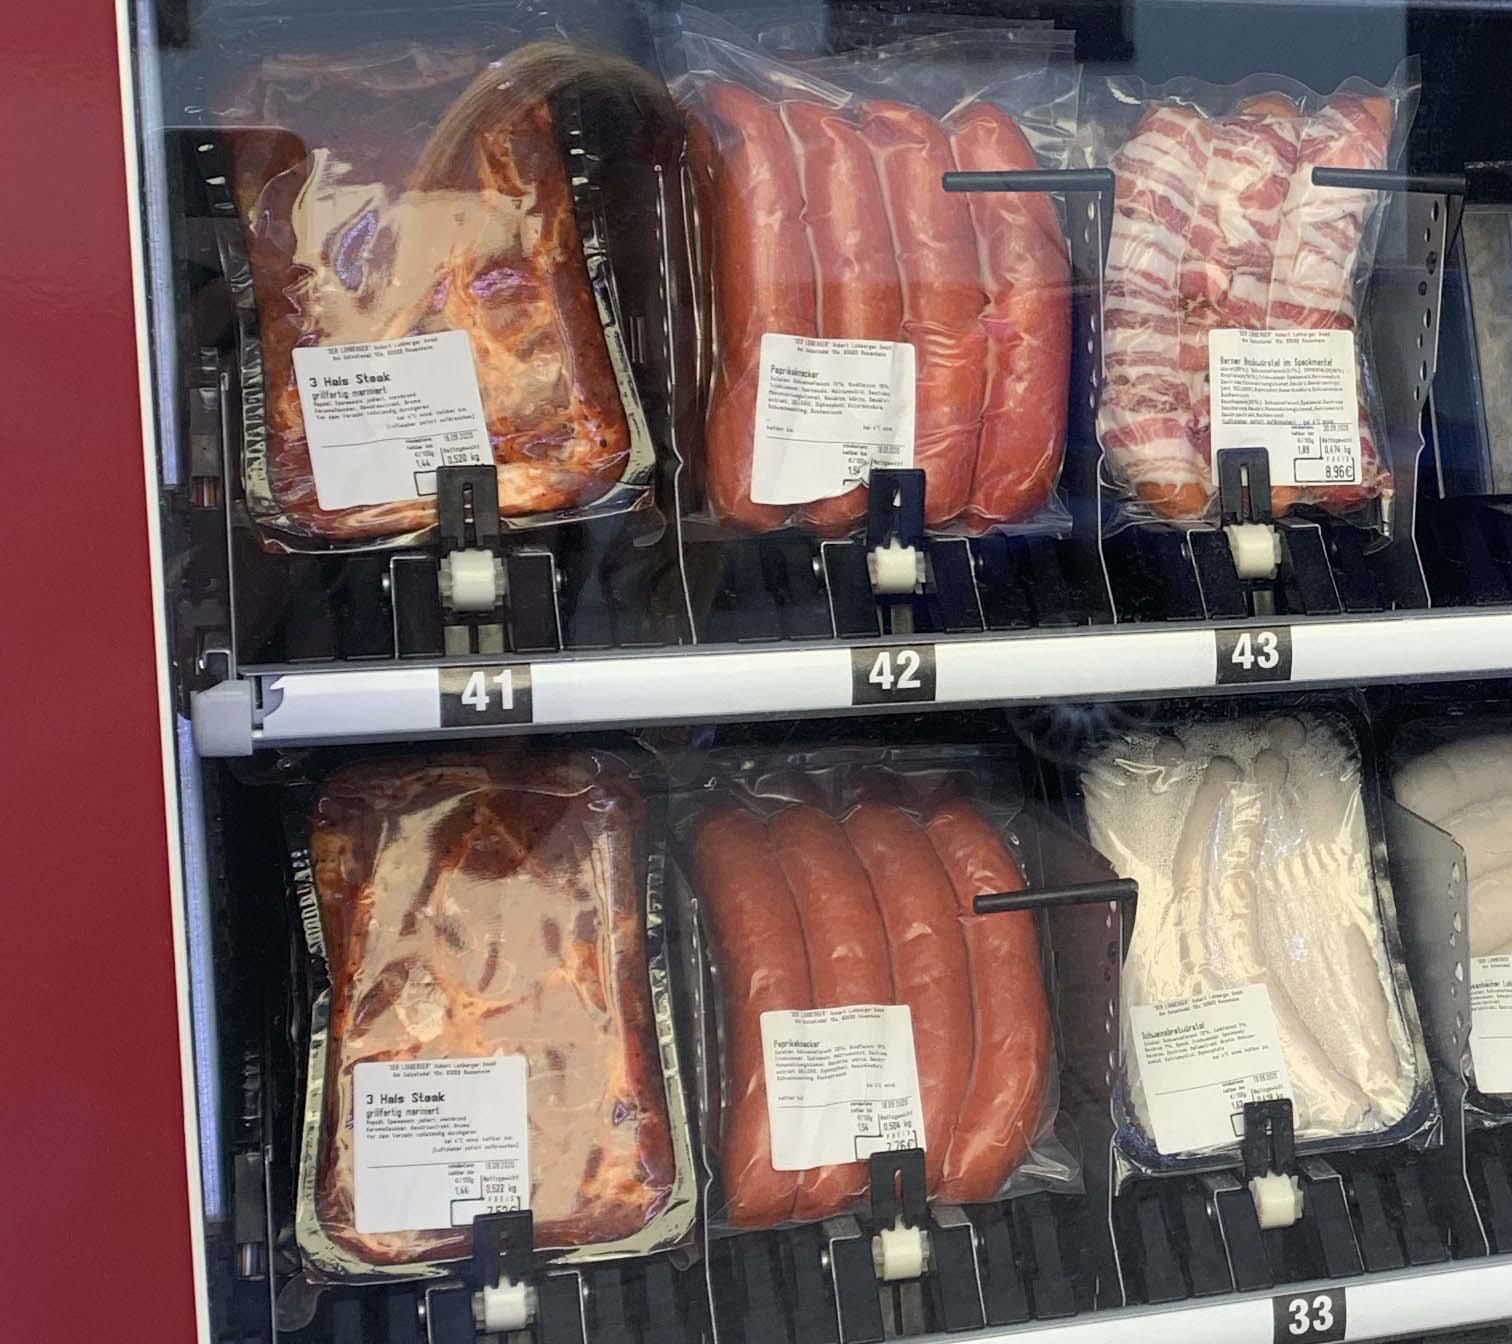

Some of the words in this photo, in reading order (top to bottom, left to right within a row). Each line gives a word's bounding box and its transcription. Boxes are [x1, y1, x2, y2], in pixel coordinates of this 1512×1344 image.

[868, 650, 921, 690] 42
[1231, 632, 1279, 669] 43
[462, 668, 516, 712] 41
[1289, 1295, 1333, 1334] 33
